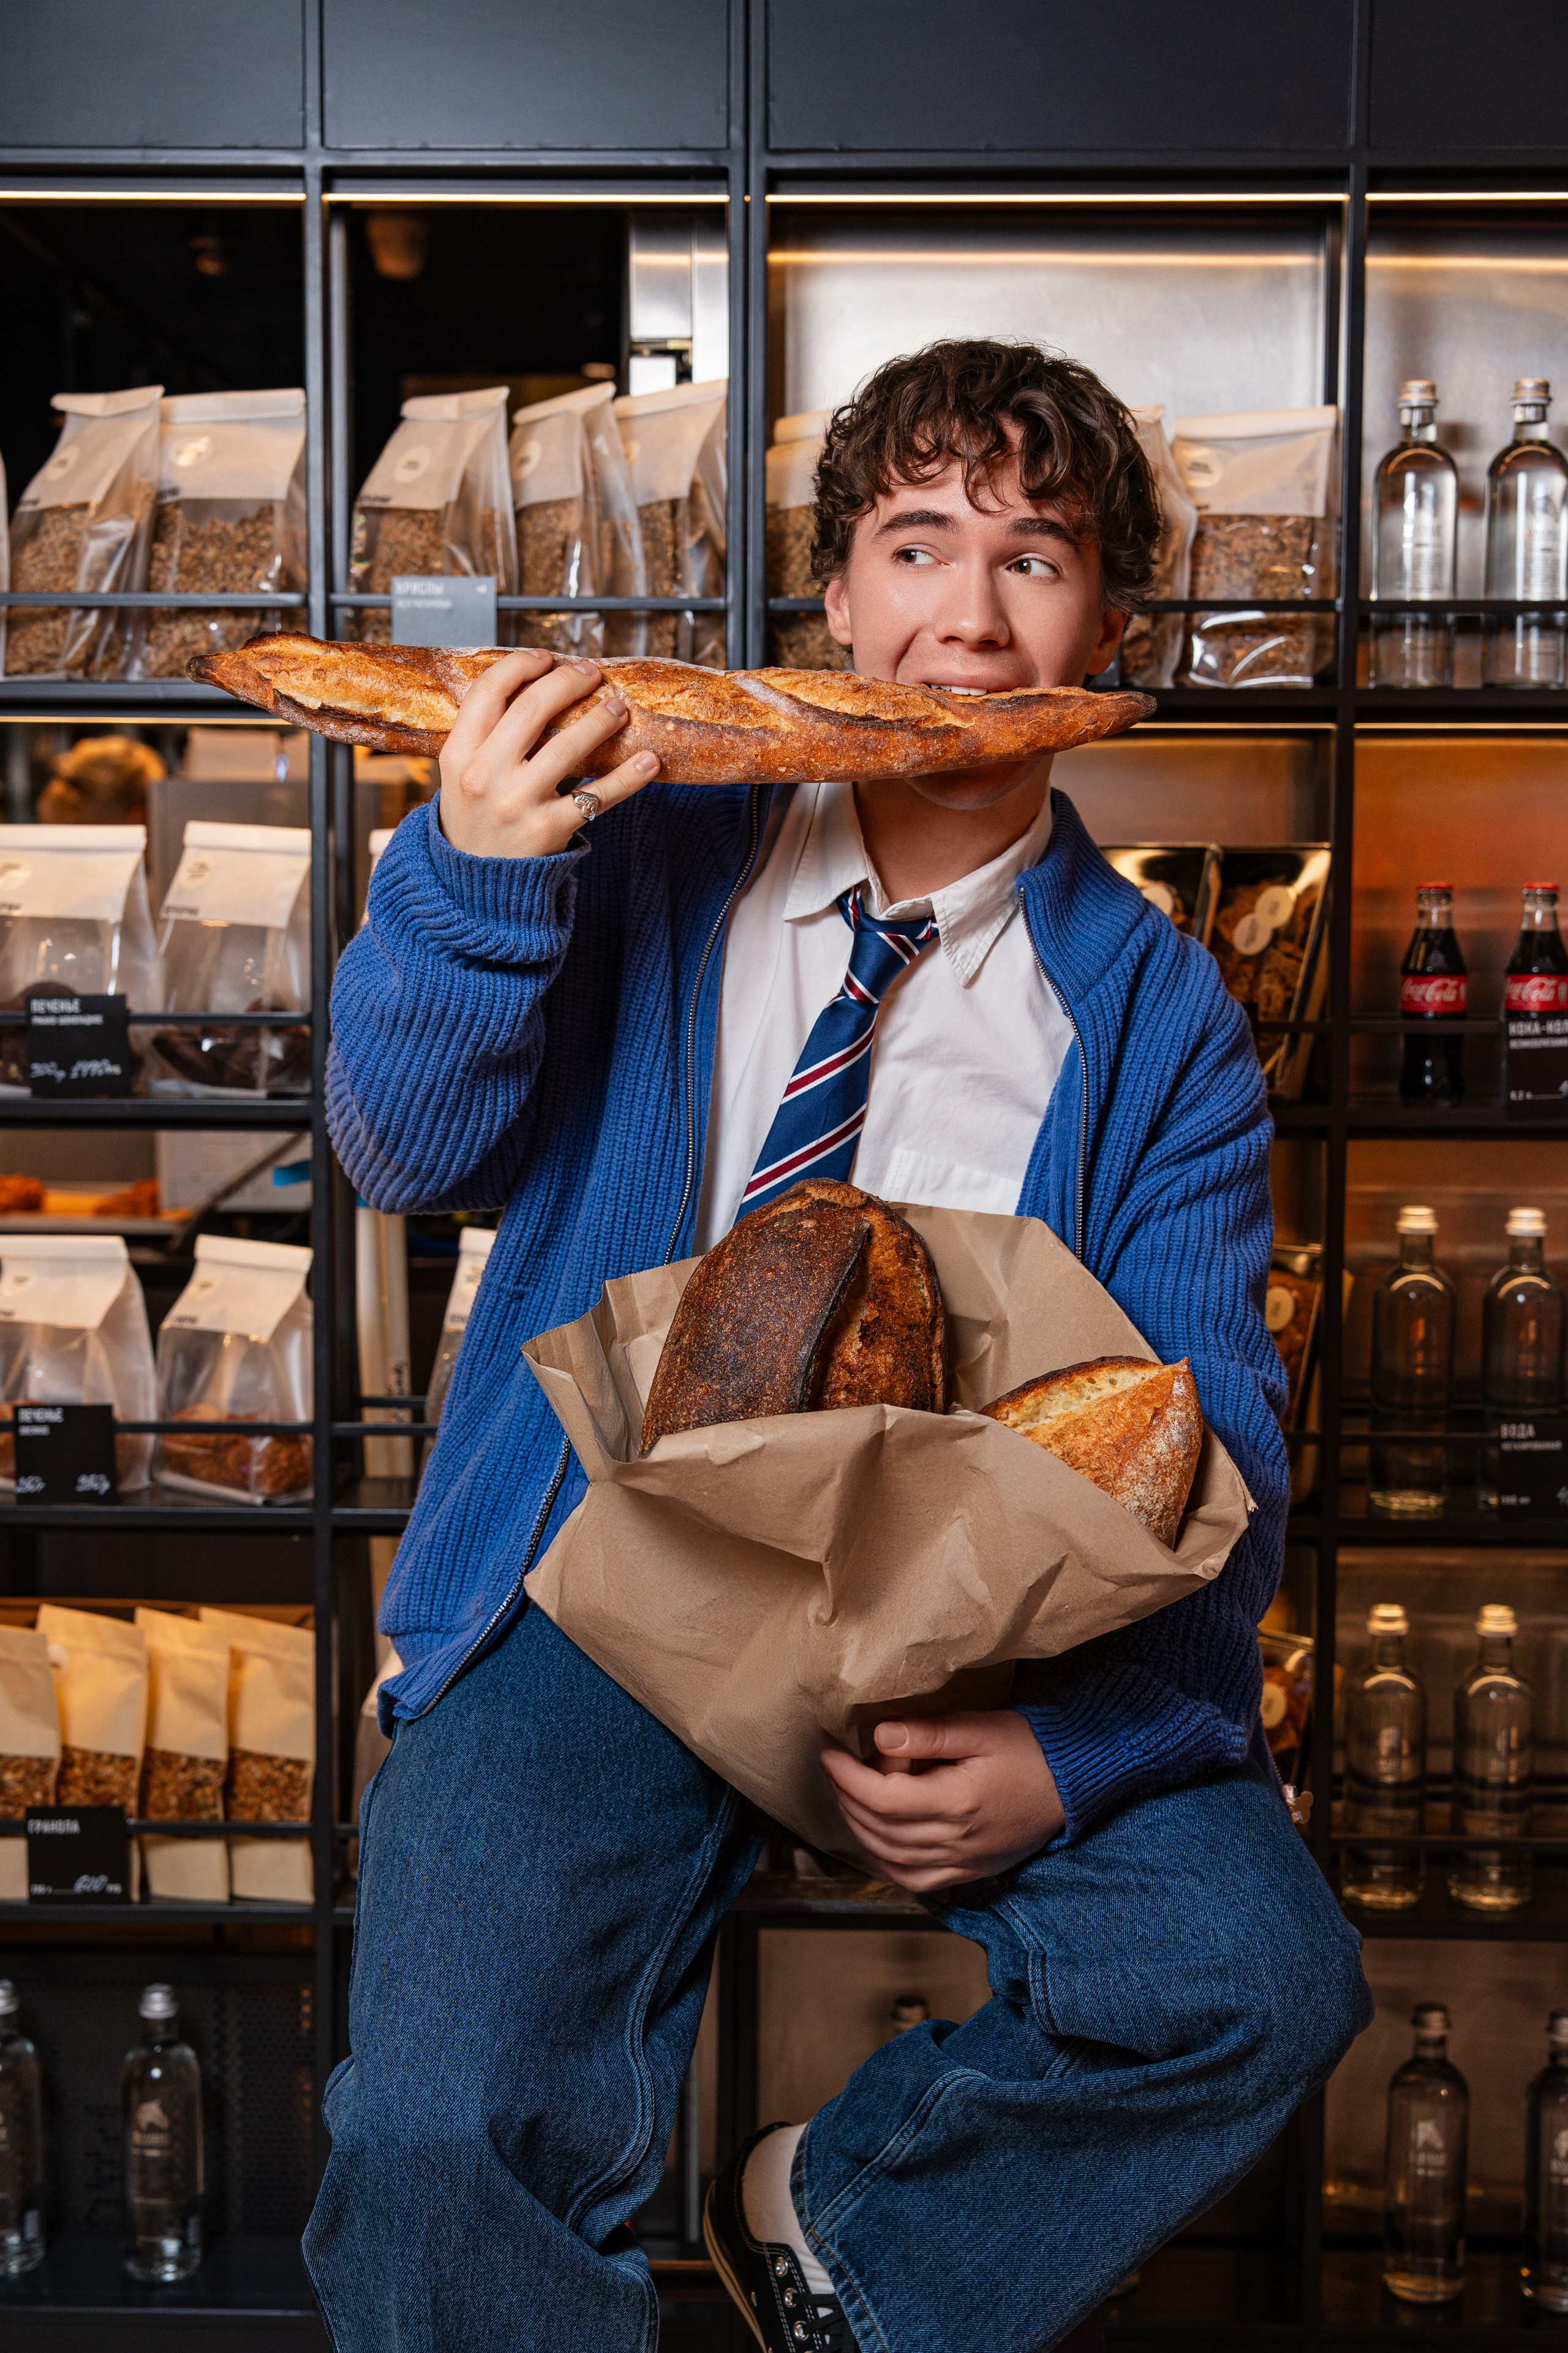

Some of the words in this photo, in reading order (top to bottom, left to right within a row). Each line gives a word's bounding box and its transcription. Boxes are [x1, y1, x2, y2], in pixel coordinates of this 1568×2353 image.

[31, 999, 80, 1013] ПЕЧЕНЬЕ
[18, 1408, 64, 1423] ПЕЧЕНЬЕ
[1500, 1423, 1536, 1439] ВОДА
[28, 1819, 80, 1834] ГРАНОЛА
